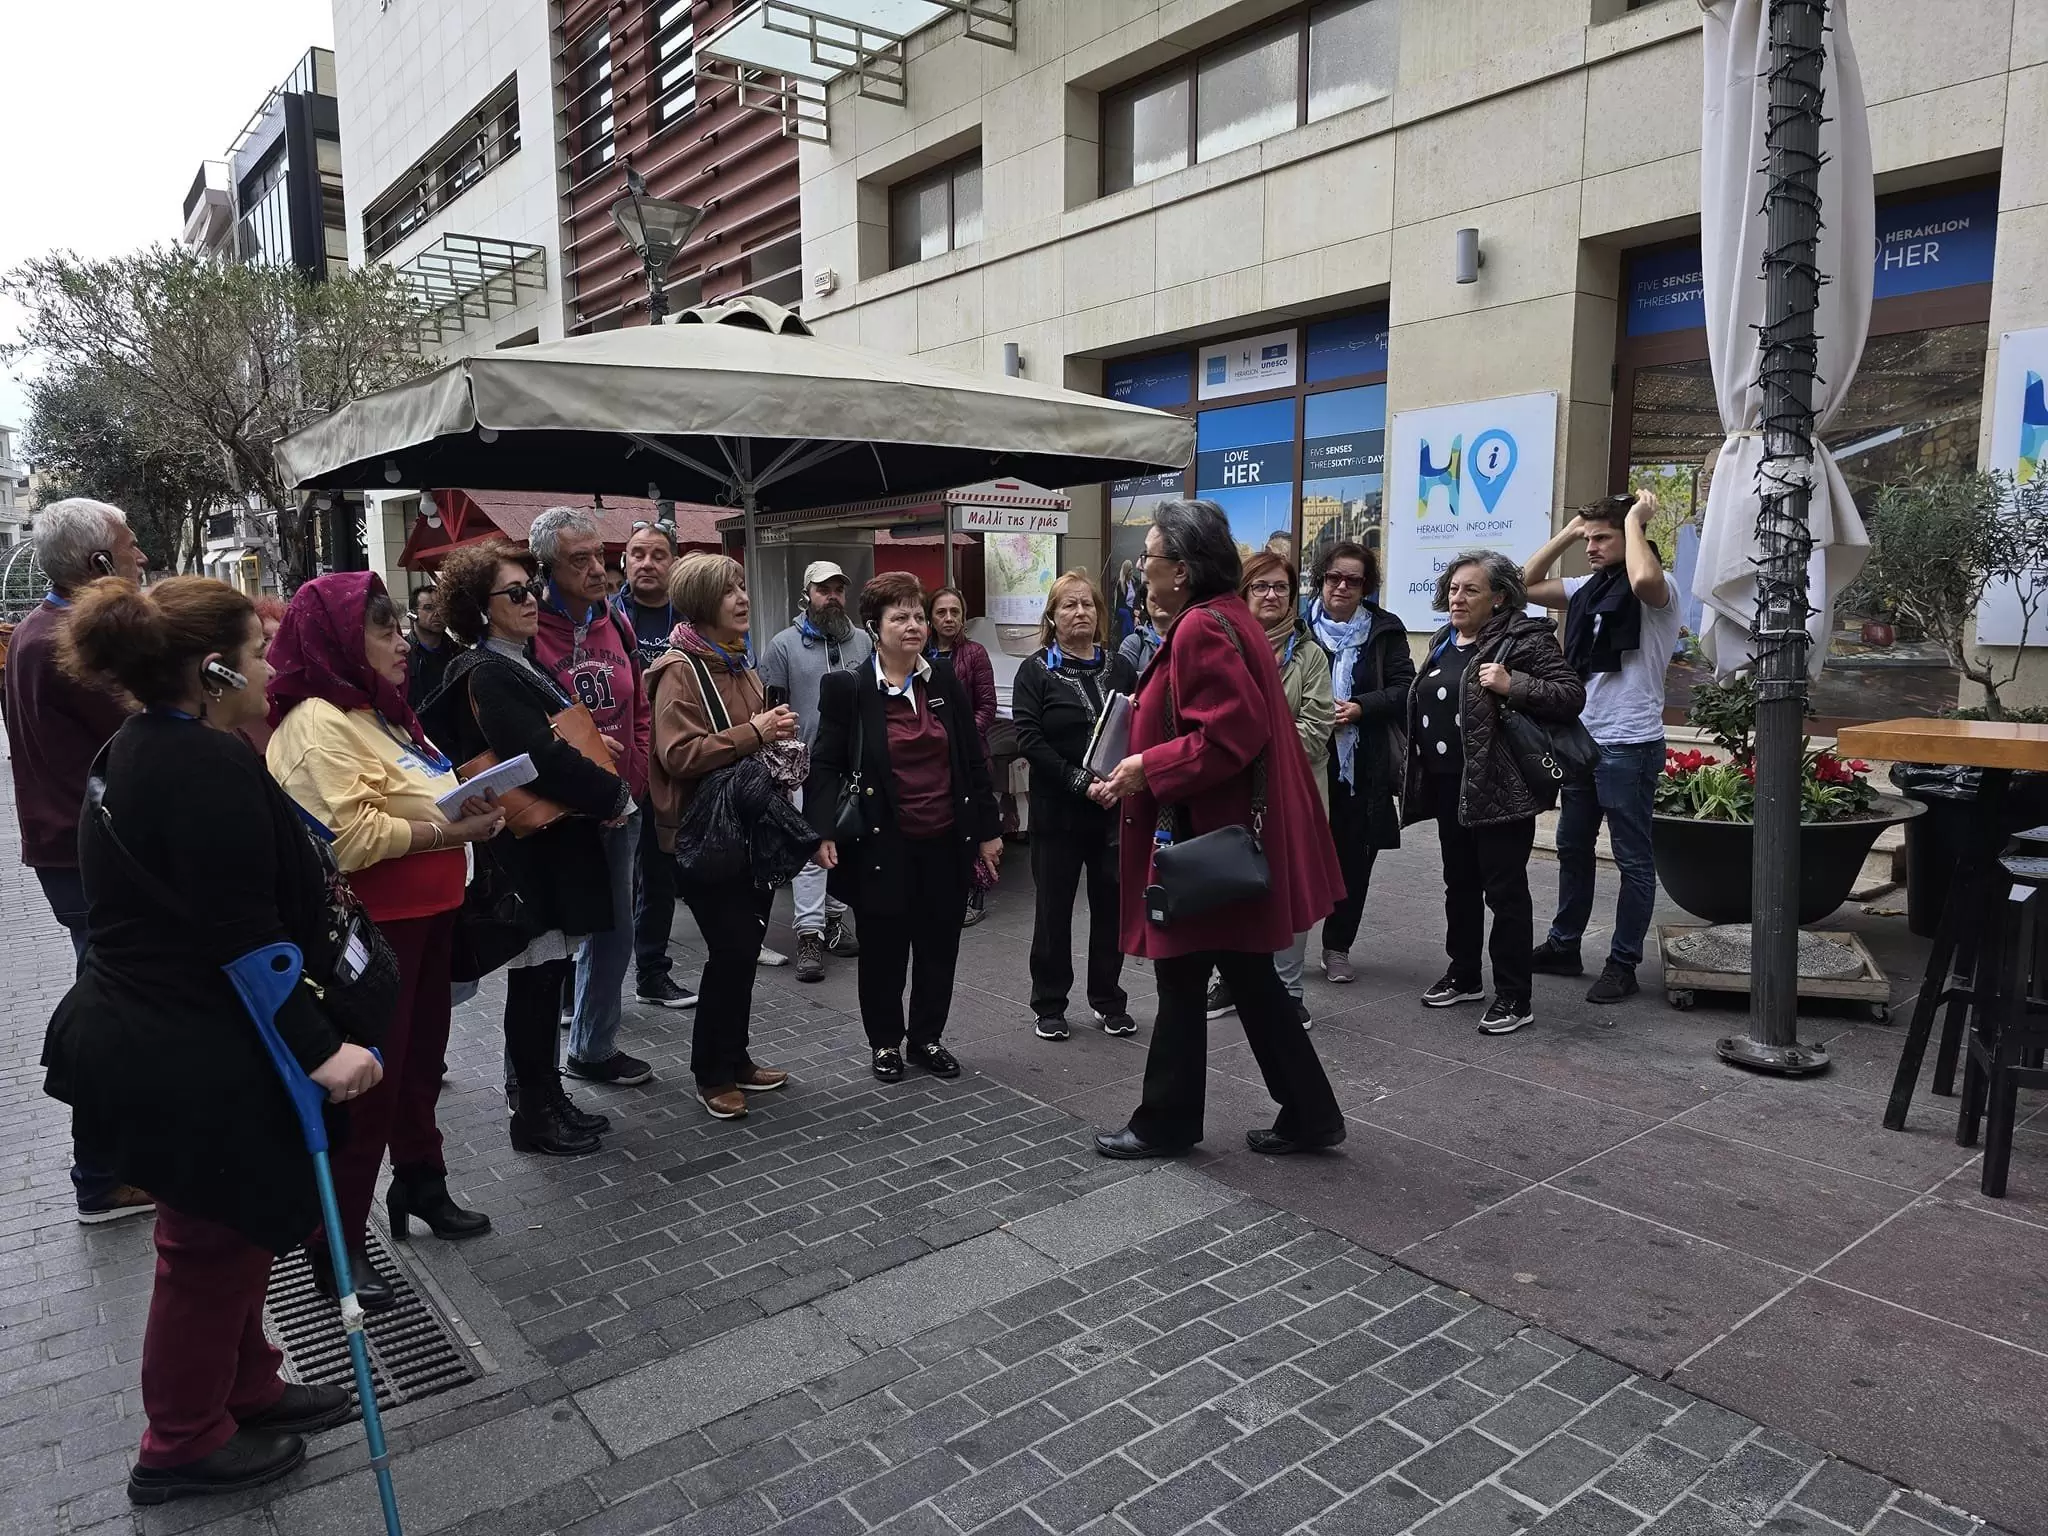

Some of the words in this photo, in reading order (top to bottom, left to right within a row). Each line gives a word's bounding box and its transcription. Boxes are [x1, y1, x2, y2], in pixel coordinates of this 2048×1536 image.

[1885, 217, 1970, 243] HERAKLION
[1883, 241, 1940, 271] HER
[1637, 279, 1660, 292] FIVE
[1662, 271, 1704, 288] SENSES
[1261, 358, 1288, 370] unesco
[1114, 386, 1132, 397] ANW
[1224, 450, 1249, 463] LOVE
[1310, 448, 1325, 457] FIVE
[1325, 444, 1353, 455] SENSES
[1310, 455, 1367, 470] THREESIXTYFIVE
[1114, 483, 1130, 493] ANW
[1161, 478, 1175, 488] HER
[967, 509, 1003, 526] Μαλλί
[1007, 515, 1025, 526] της
[1416, 523, 1460, 534] HERAKLION
[1466, 521, 1487, 531] INFO
[1487, 520, 1514, 530] POINT
[573, 670, 616, 712] 81
